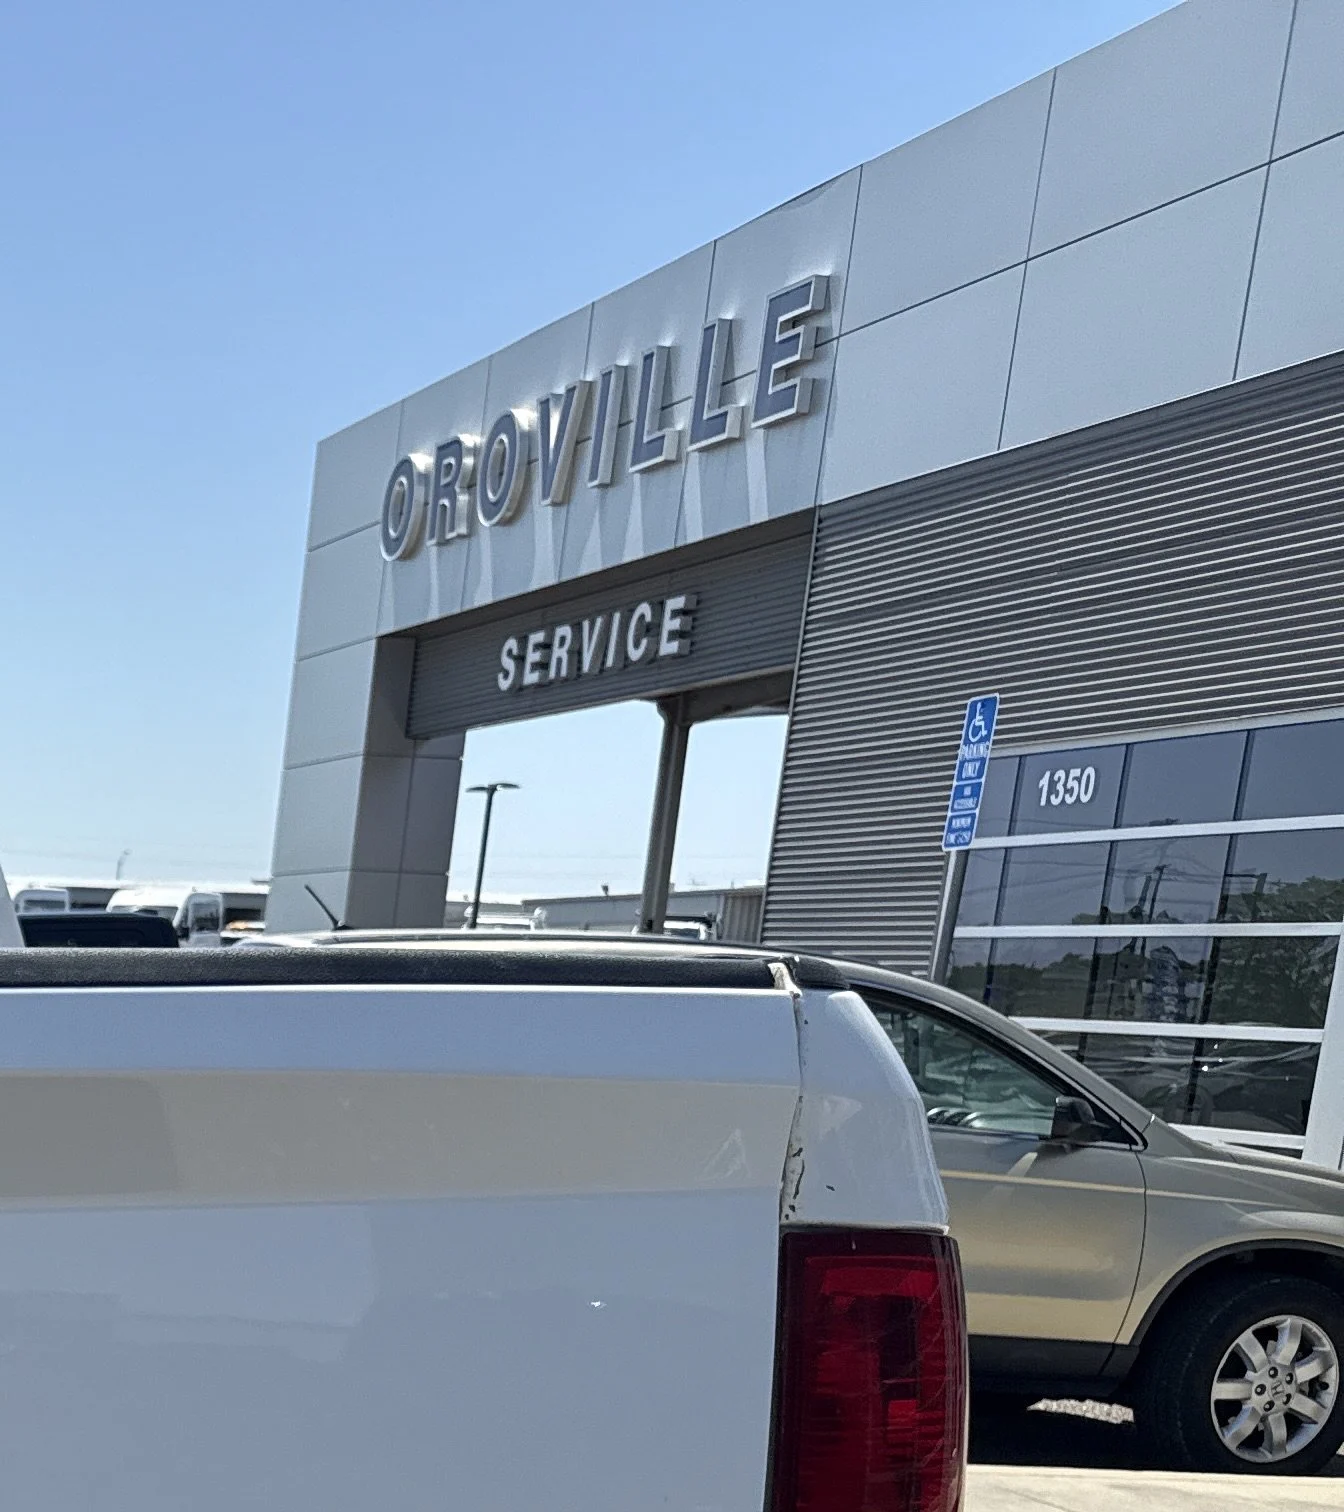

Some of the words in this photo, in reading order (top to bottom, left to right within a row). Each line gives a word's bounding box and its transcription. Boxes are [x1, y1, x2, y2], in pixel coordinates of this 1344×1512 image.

[380, 274, 830, 562] OROVILLE
[497, 594, 693, 692] SERVICE
[1038, 766, 1096, 807] 1350
